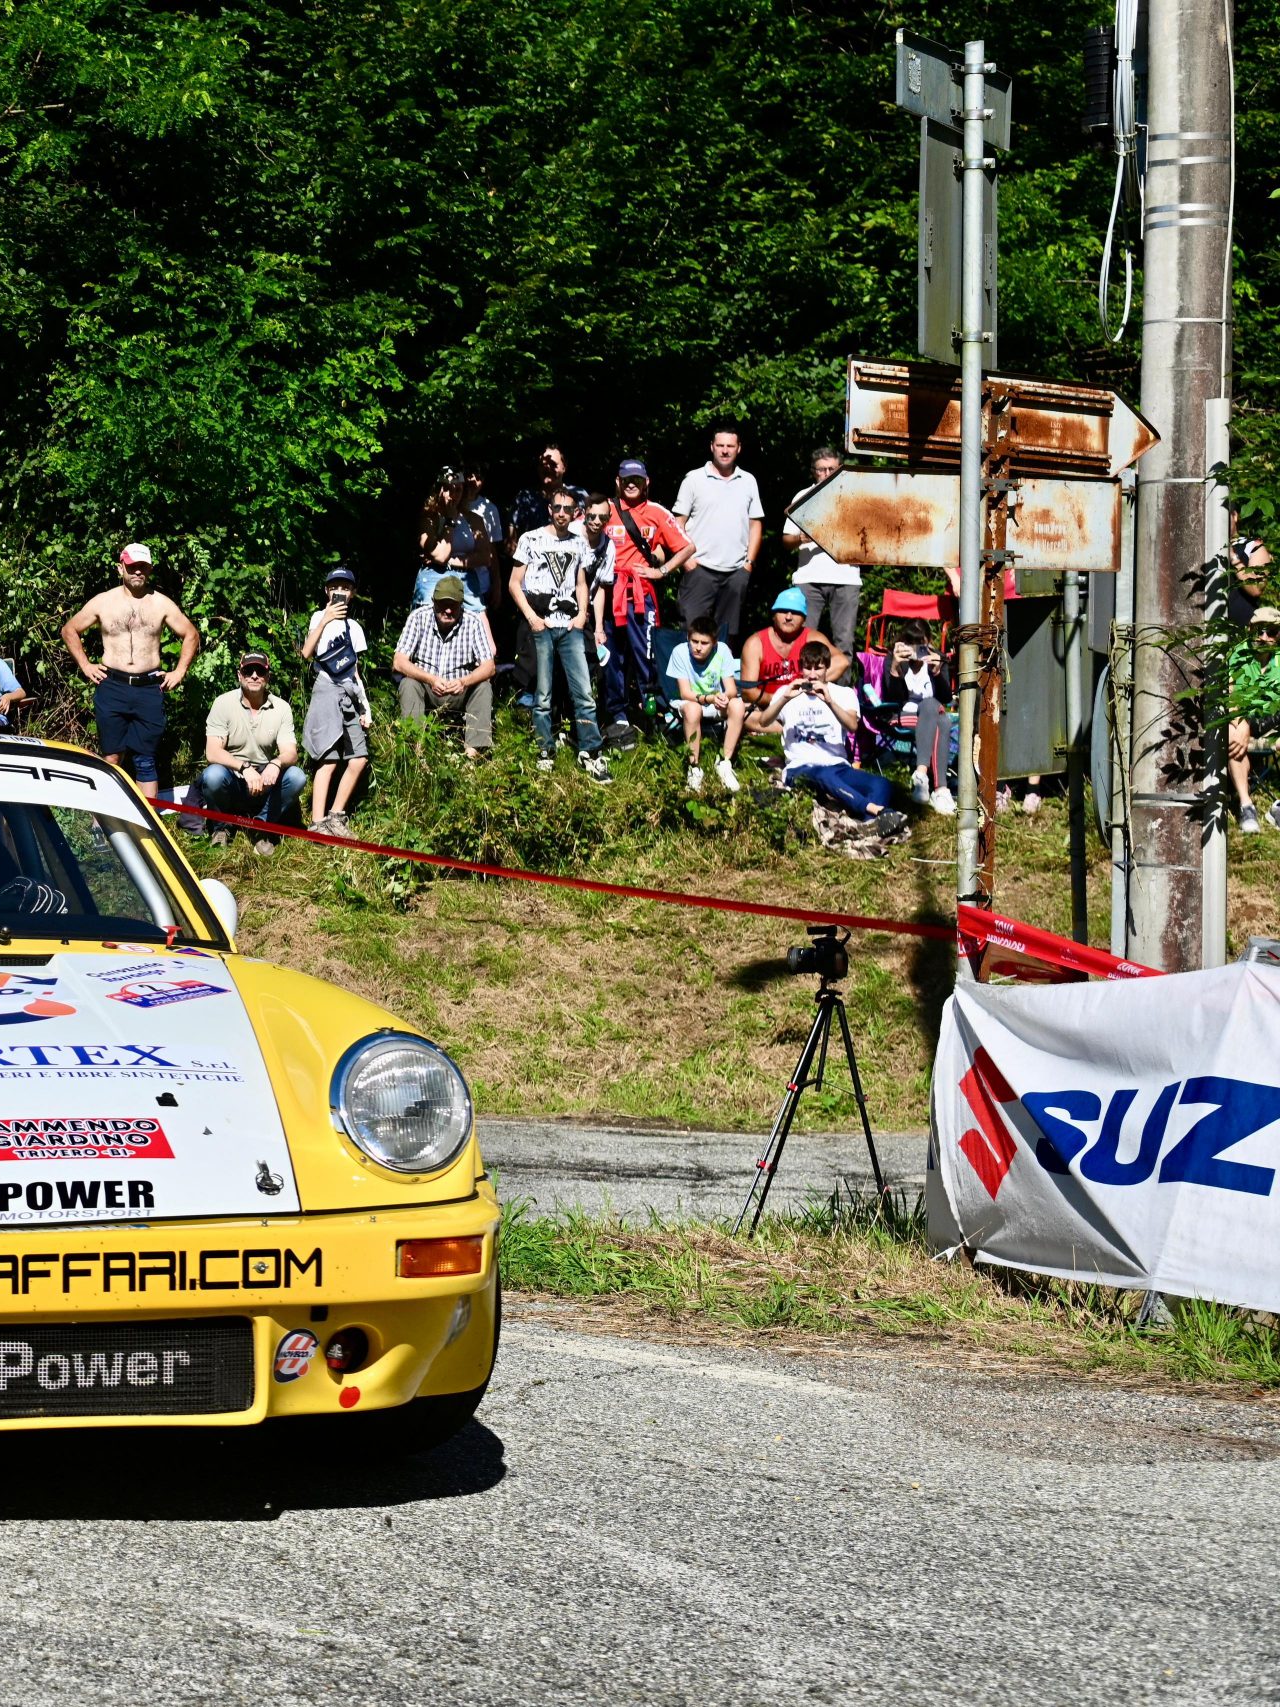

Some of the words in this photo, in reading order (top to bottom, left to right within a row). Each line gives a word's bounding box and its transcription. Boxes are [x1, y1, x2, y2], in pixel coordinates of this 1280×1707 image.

[191, 1060, 237, 1070] S.r.l.
[39, 1071, 52, 1079] E
[57, 1071, 117, 1079] FIBRE
[120, 1071, 245, 1083] SINTETICHE
[14, 1149, 98, 1158] TRIVERO
[0, 1209, 154, 1221] MOTORSPORT
